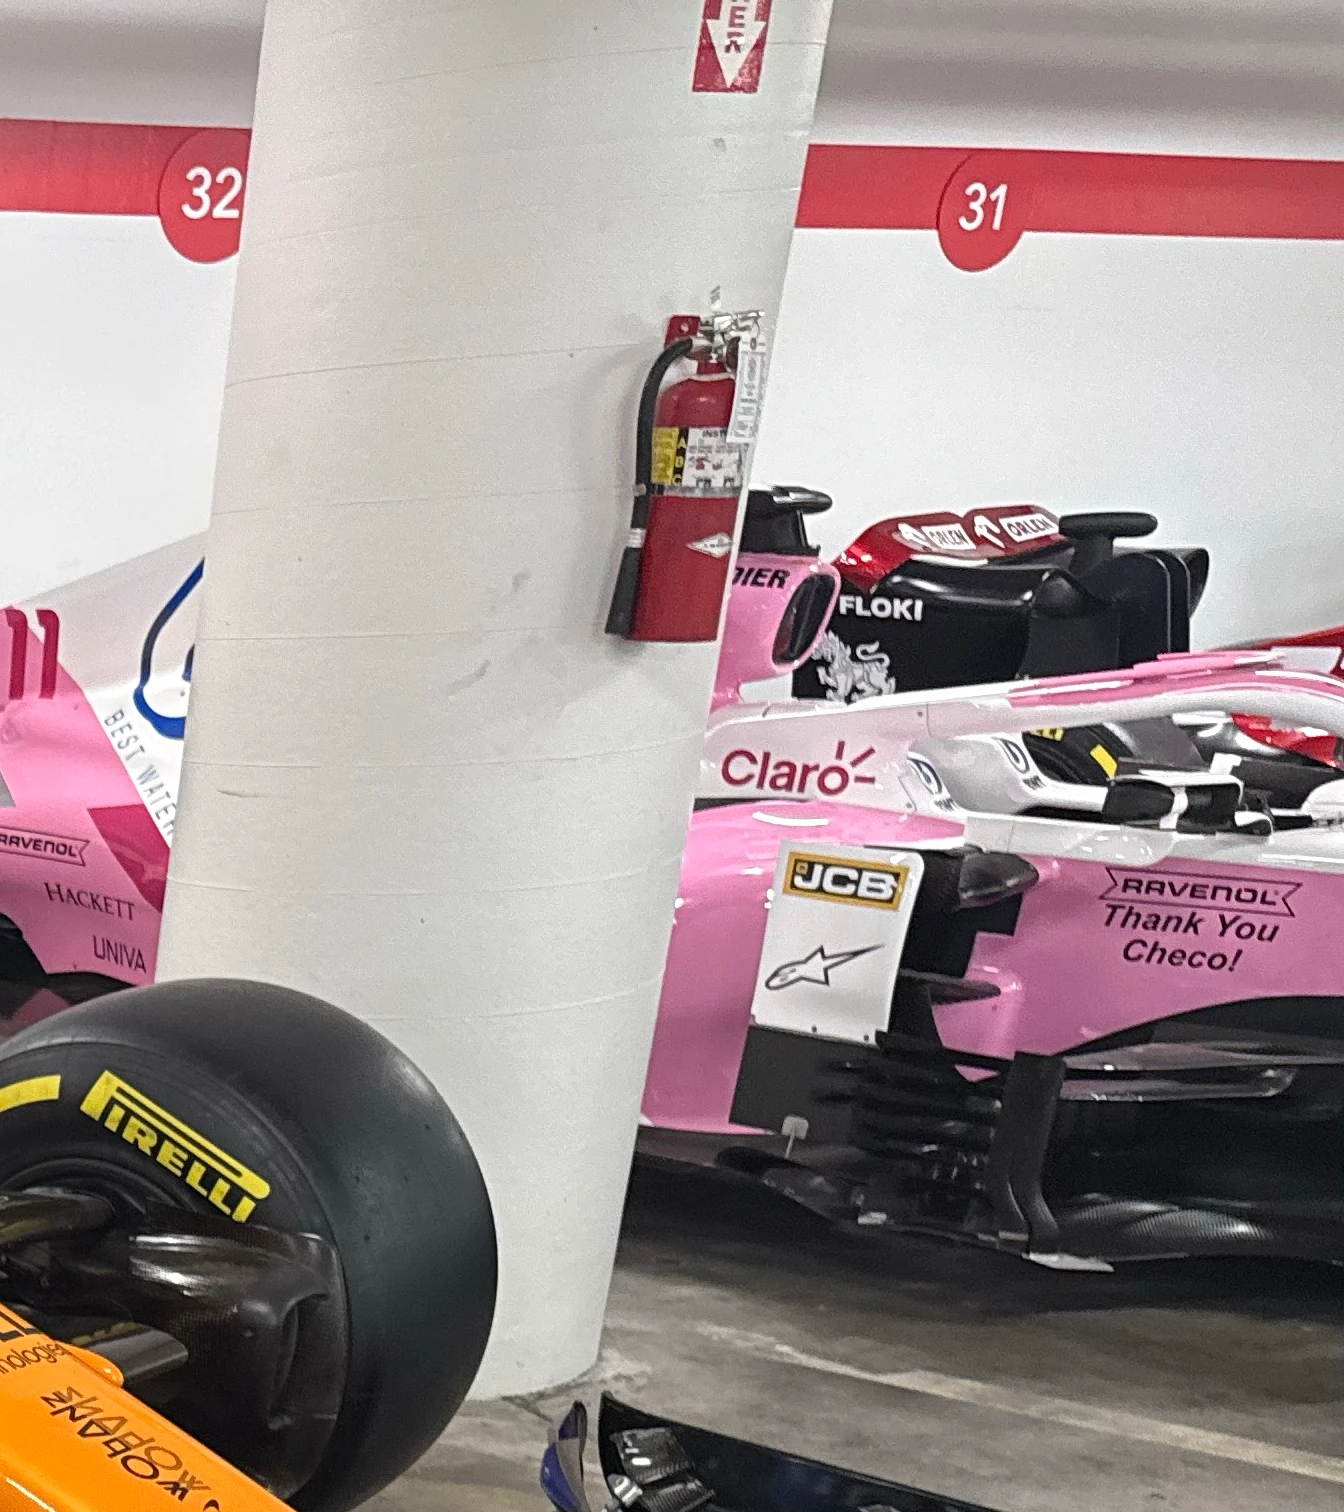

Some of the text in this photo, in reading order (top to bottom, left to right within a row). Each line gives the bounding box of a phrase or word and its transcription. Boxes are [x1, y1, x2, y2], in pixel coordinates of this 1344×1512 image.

[181, 166, 241, 220] 32
[958, 184, 1009, 232] 31
[839, 595, 923, 622] FLOKI
[5, 606, 60, 701] 11
[104, 709, 146, 762] BEST
[721, 748, 850, 796] Claro
[44, 882, 136, 921] HACKETT
[793, 862, 896, 901] JCB
[1122, 877, 1277, 907] RAVENOL
[1104, 903, 1280, 943] Thank You
[93, 935, 147, 974] UNIVA
[1123, 938, 1244, 973] Checo!
[80, 1070, 270, 1223] PIRELLI
